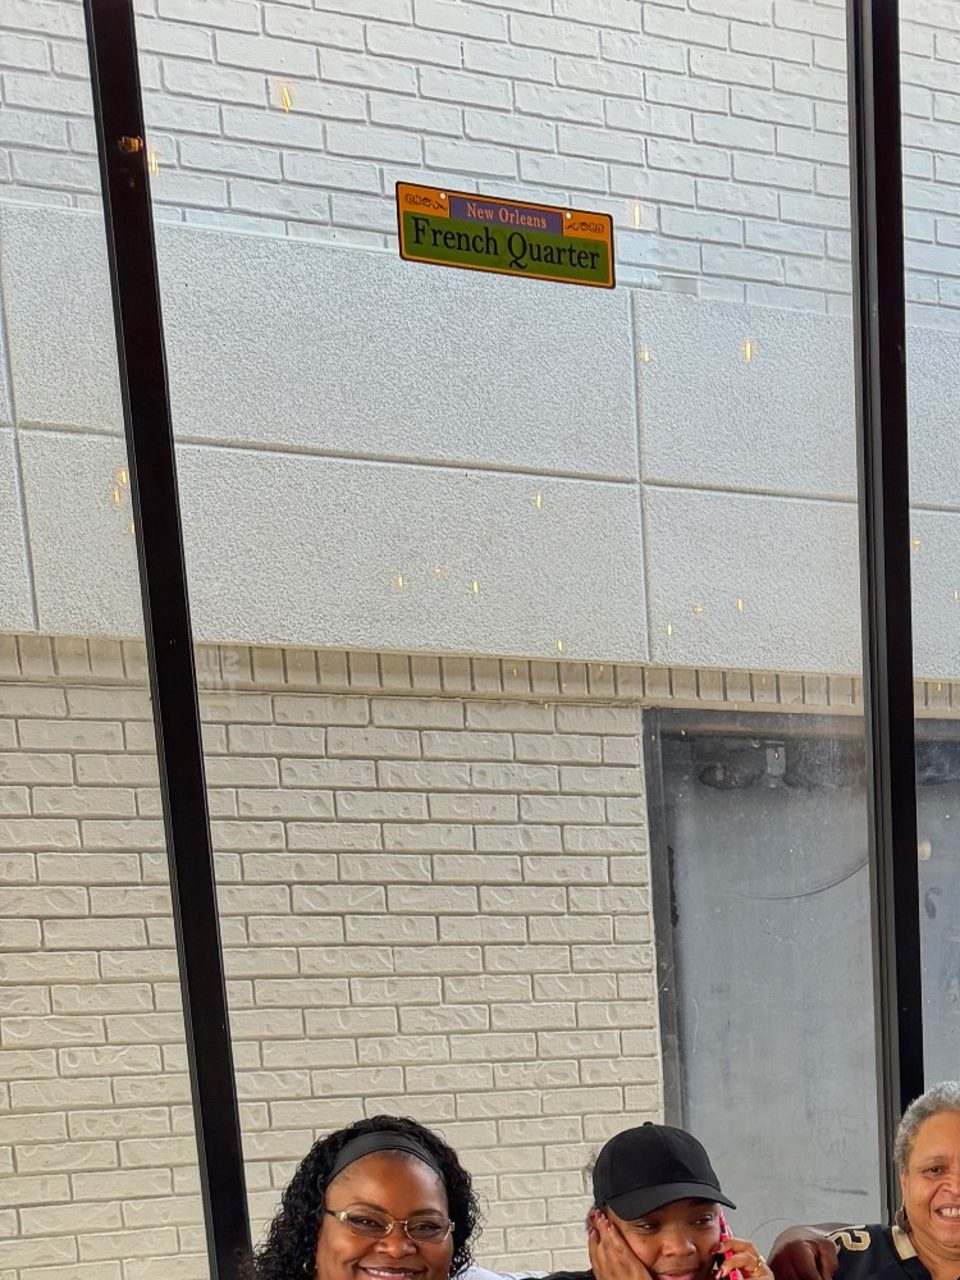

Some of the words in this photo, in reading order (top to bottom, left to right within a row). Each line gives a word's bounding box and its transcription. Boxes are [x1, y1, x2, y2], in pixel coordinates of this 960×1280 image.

[466, 202, 494, 217] New
[498, 210, 547, 229] Orleans
[411, 216, 499, 256] French
[507, 232, 601, 271] Quarter
